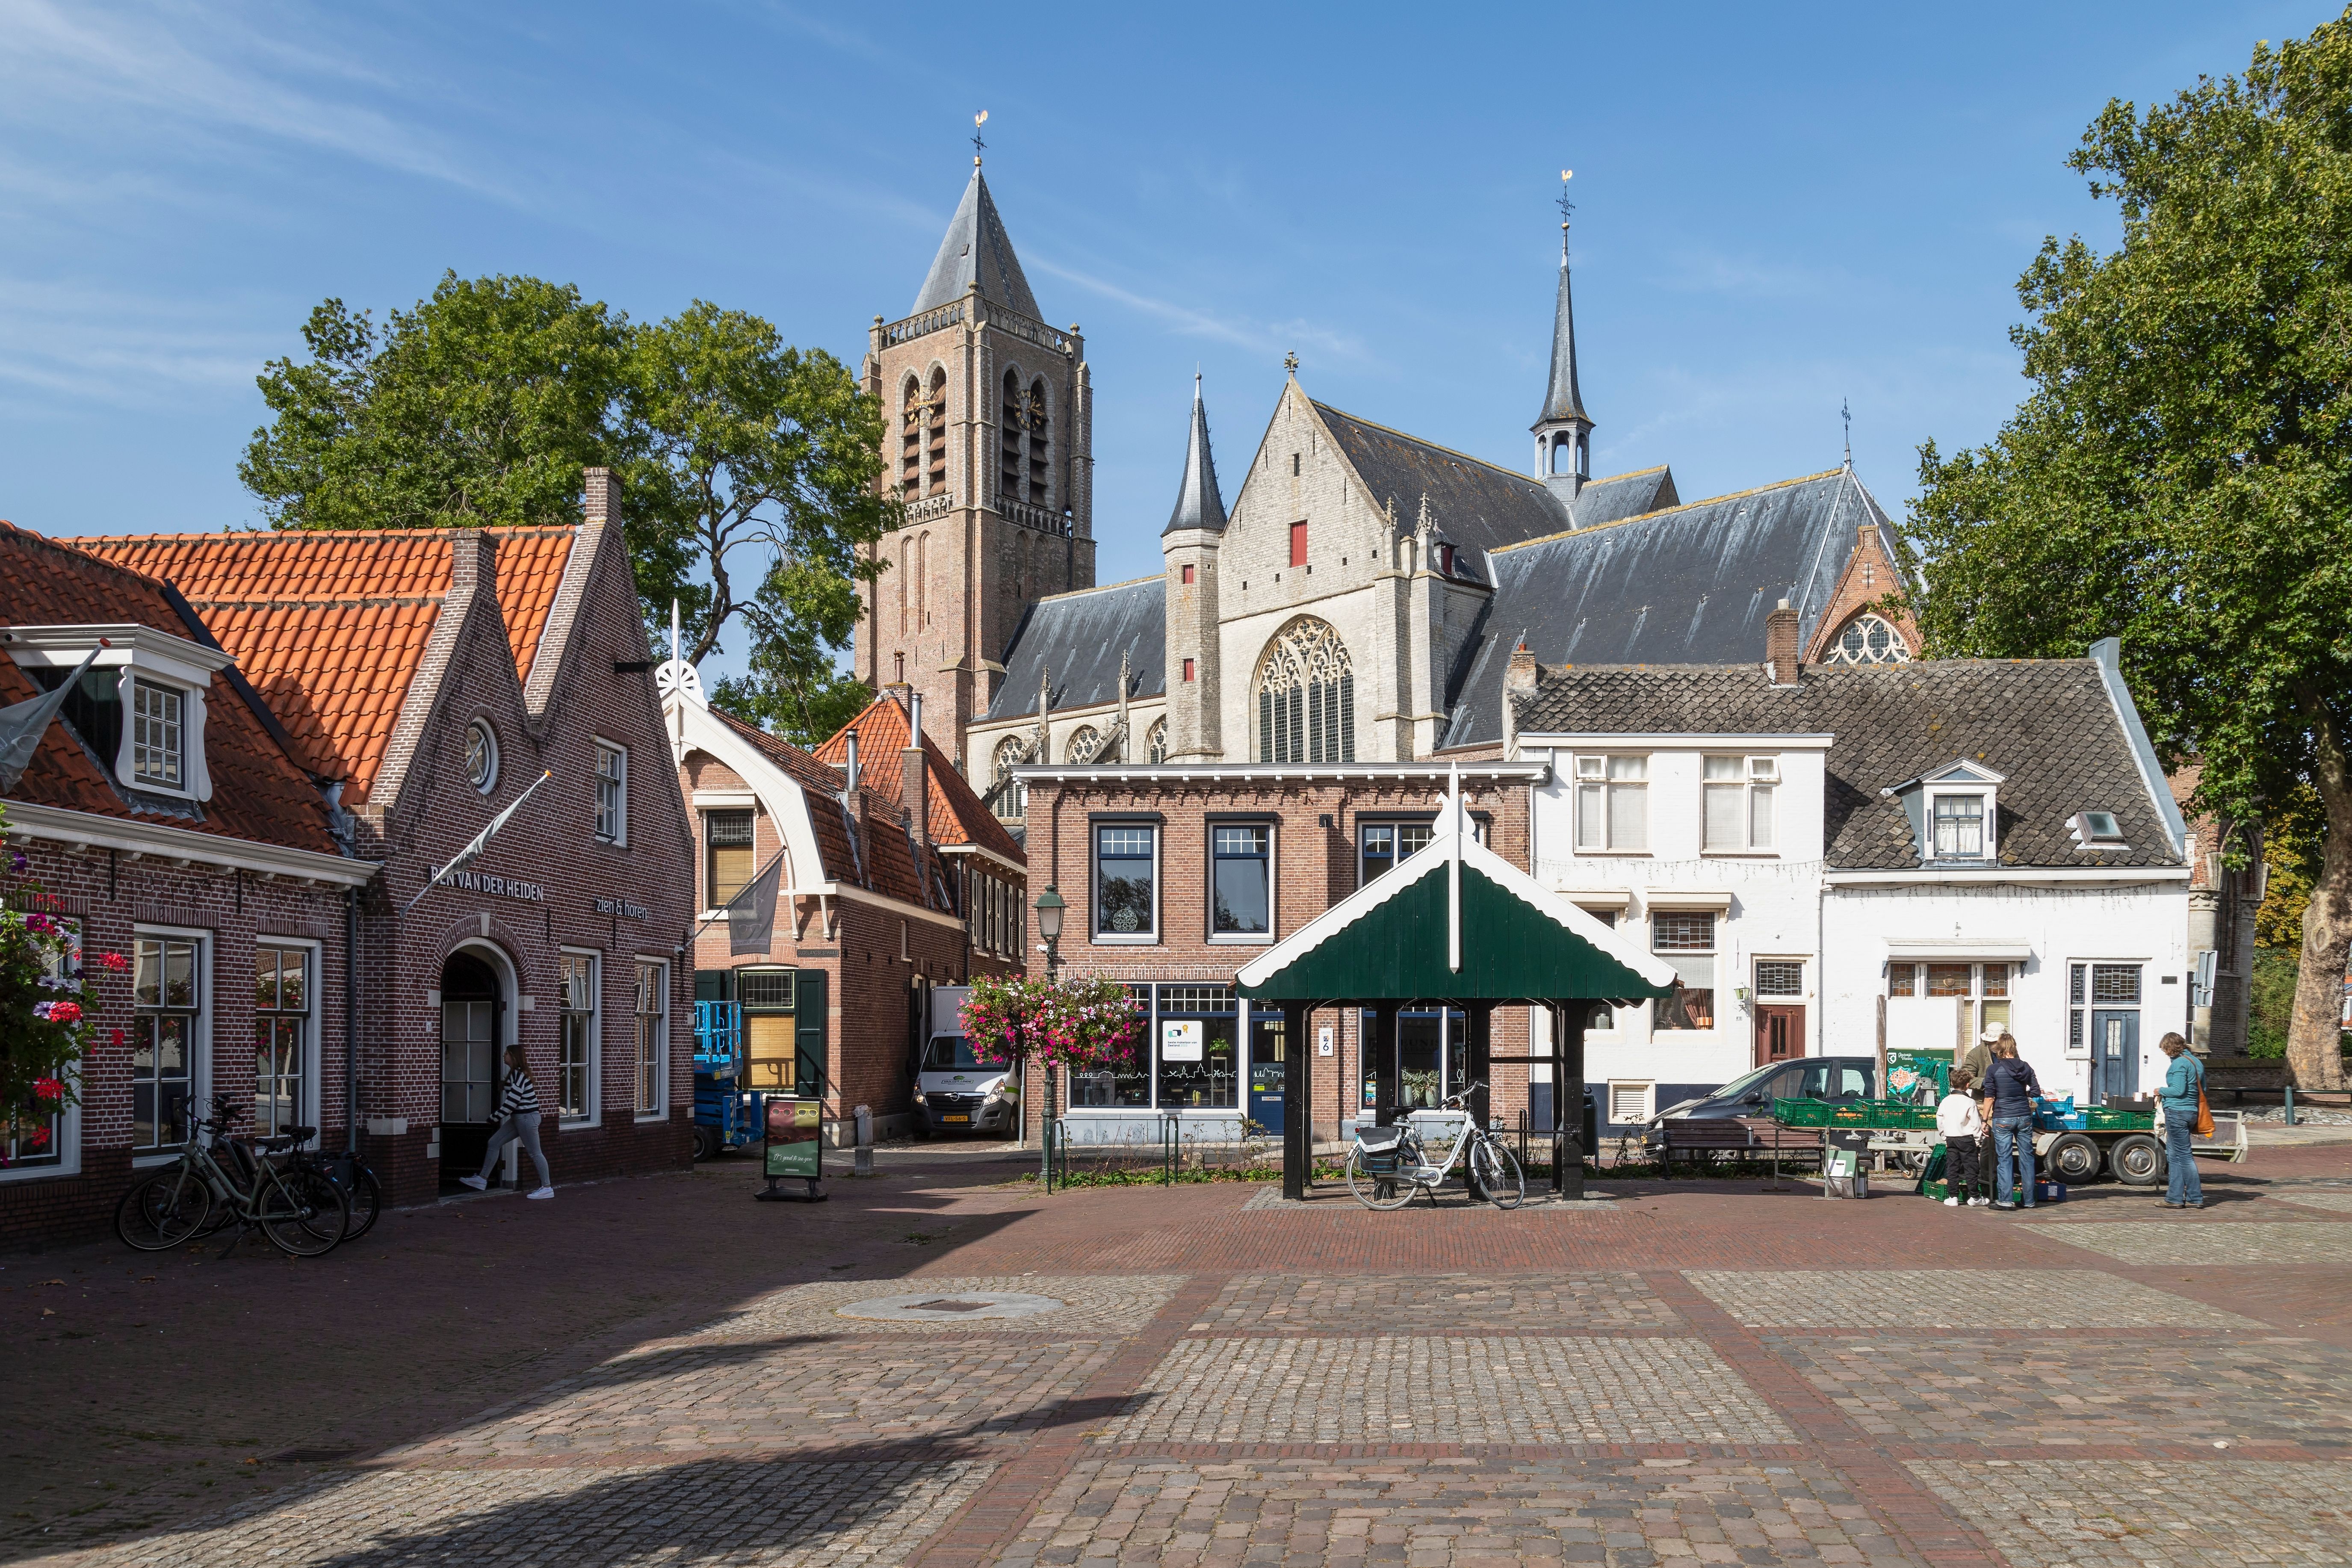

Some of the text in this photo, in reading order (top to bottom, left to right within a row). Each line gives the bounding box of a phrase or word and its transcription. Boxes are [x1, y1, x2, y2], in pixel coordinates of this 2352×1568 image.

[458, 872, 480, 891] VAN
[483, 875, 504, 895] DER
[507, 880, 544, 901] HEIDEN
[597, 896, 647, 919] zien & horen
[1323, 1042, 1329, 1051] 6
